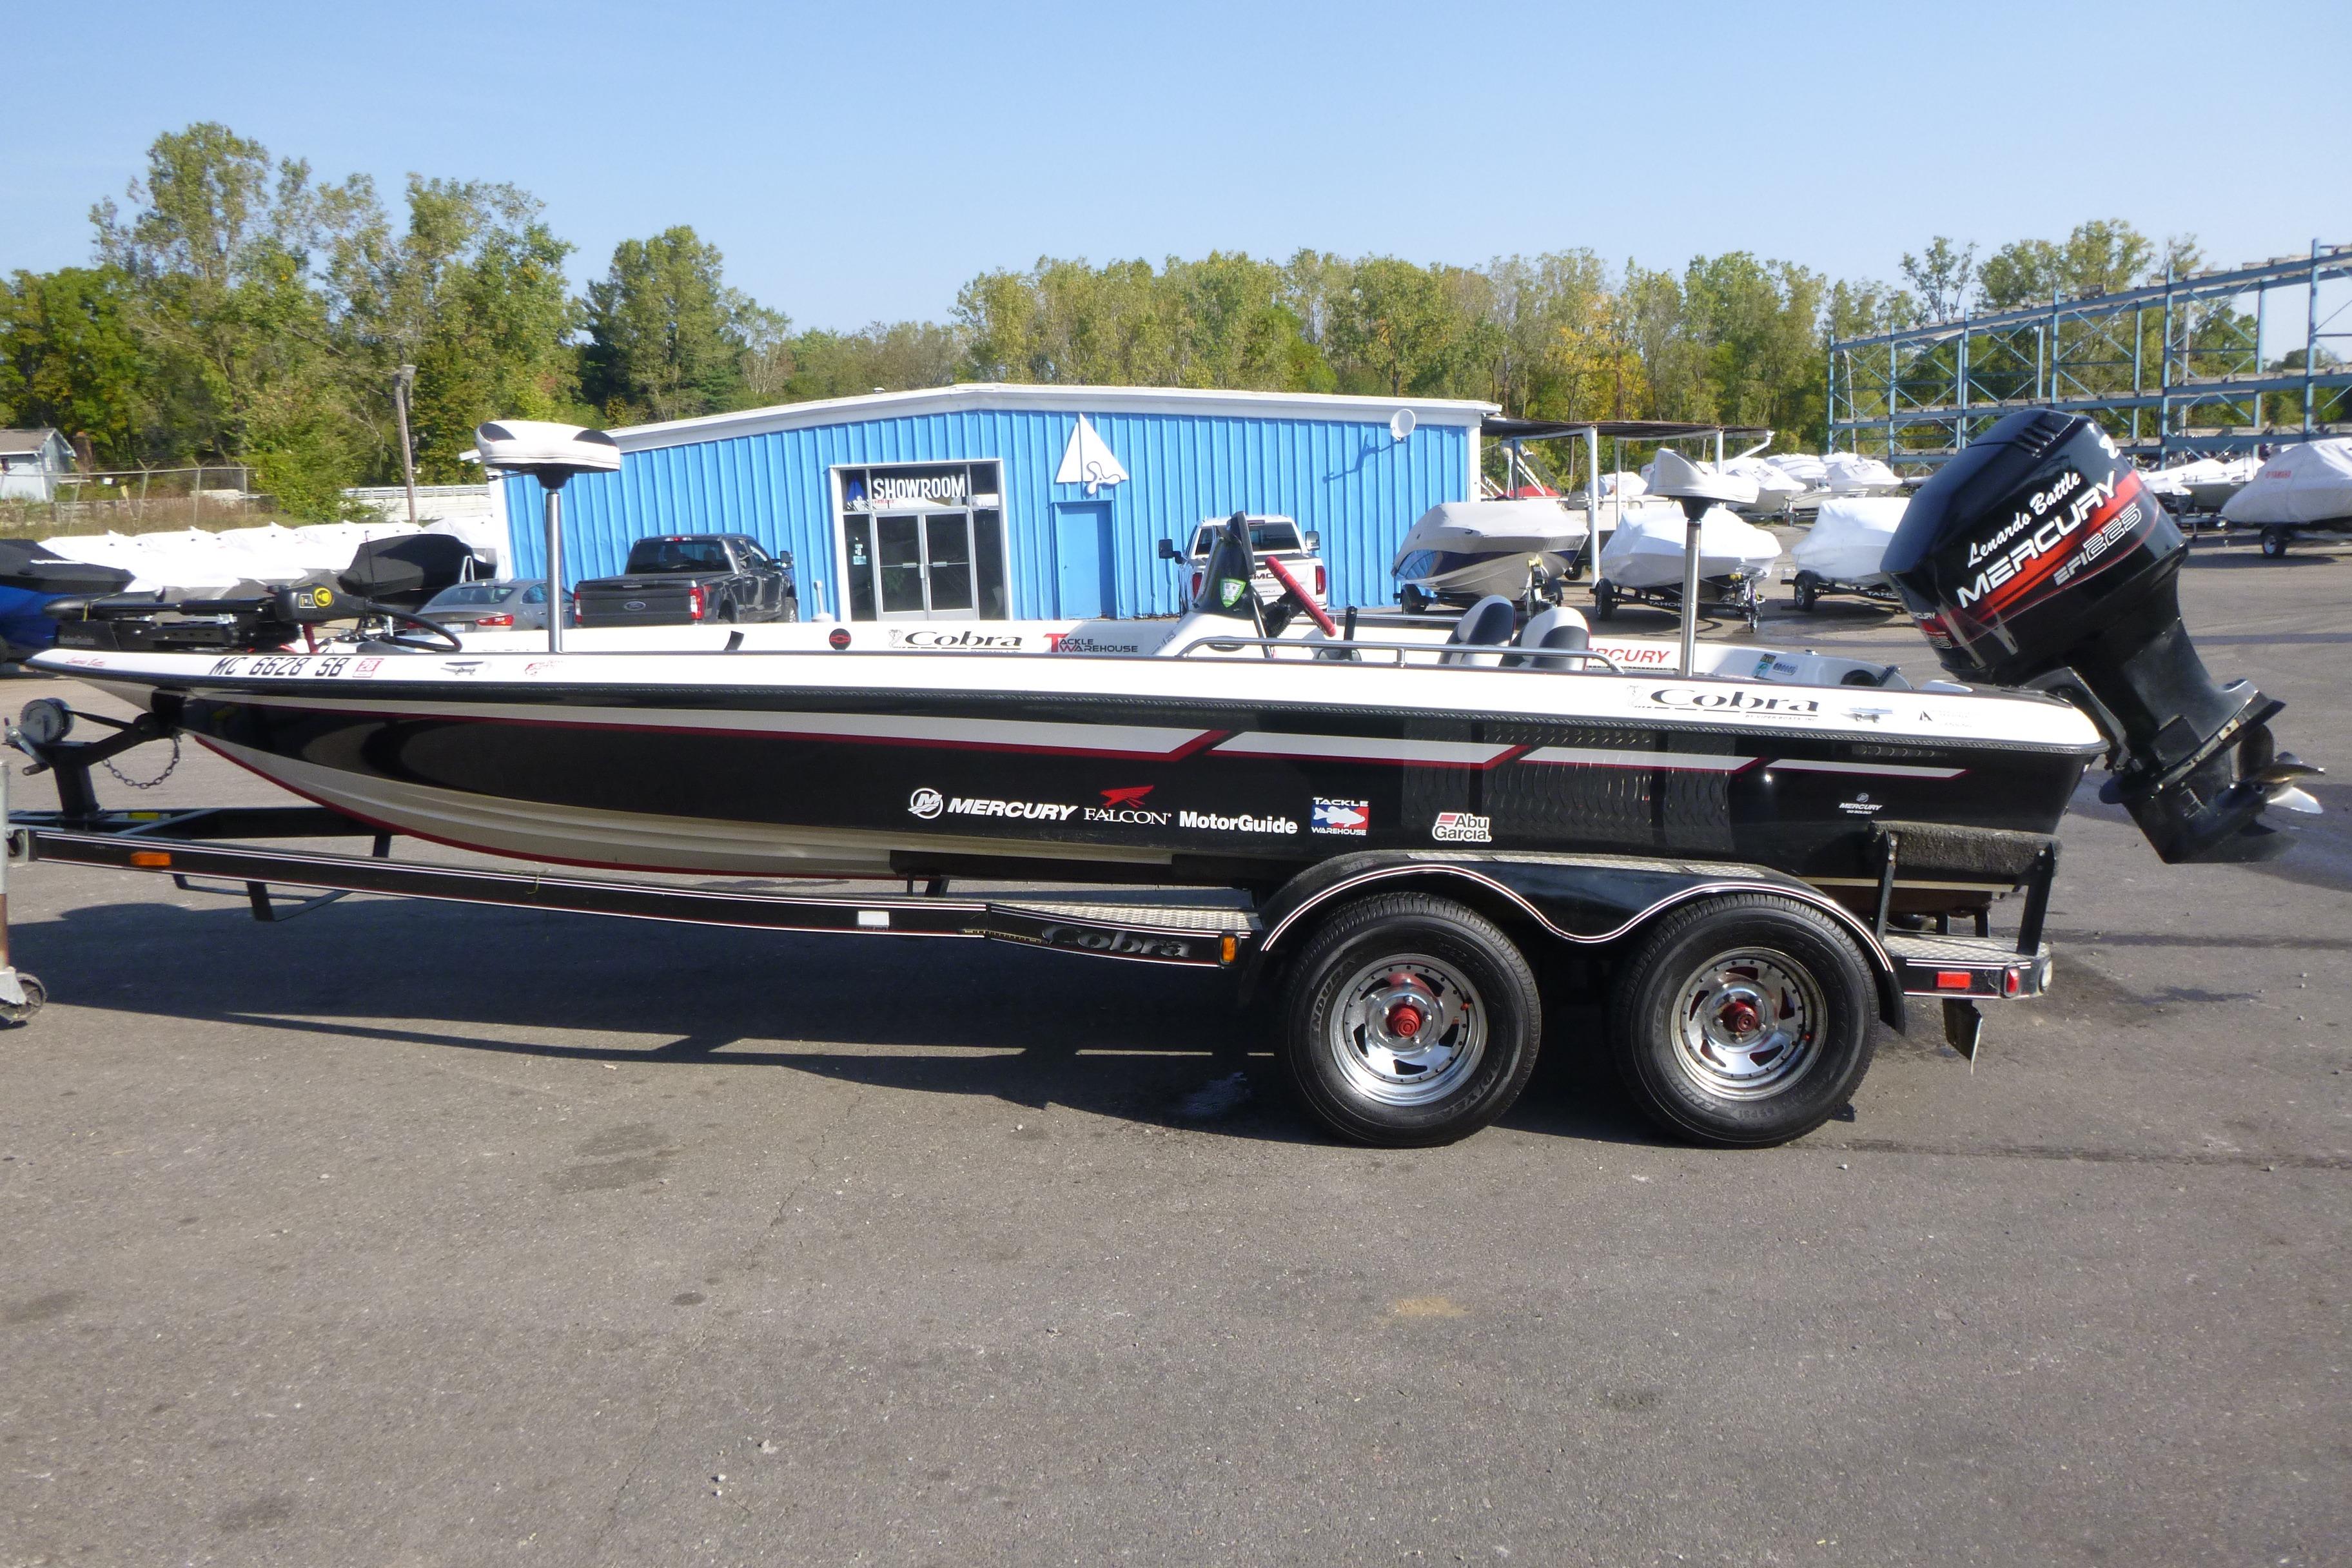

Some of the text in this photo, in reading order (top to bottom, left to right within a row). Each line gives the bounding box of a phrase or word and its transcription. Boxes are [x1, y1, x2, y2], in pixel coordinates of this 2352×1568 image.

[874, 474, 965, 500] SHOWROOM
[1968, 472, 2081, 568] Lenardo Battle
[1957, 471, 2115, 609] MERCURY
[905, 631, 1023, 647] Cobra
[1043, 633, 1094, 653] TACKLE
[1059, 645, 1139, 653] WAREHOUSE
[209, 656, 352, 677] MC 6628 SB
[1651, 689, 1819, 712] Cobra
[947, 798, 1078, 821] MERCURY
[1313, 797, 1369, 807] TACKLE
[1839, 802, 1883, 810] MERCURY
[1083, 808, 1168, 825] FALCON
[1179, 811, 1298, 834] MotorGuide
[1455, 815, 1487, 828] Abu
[1311, 827, 1367, 836] WAREHOUSE
[1434, 825, 1487, 840] Garcia
[1042, 925, 1191, 957] Cobra
